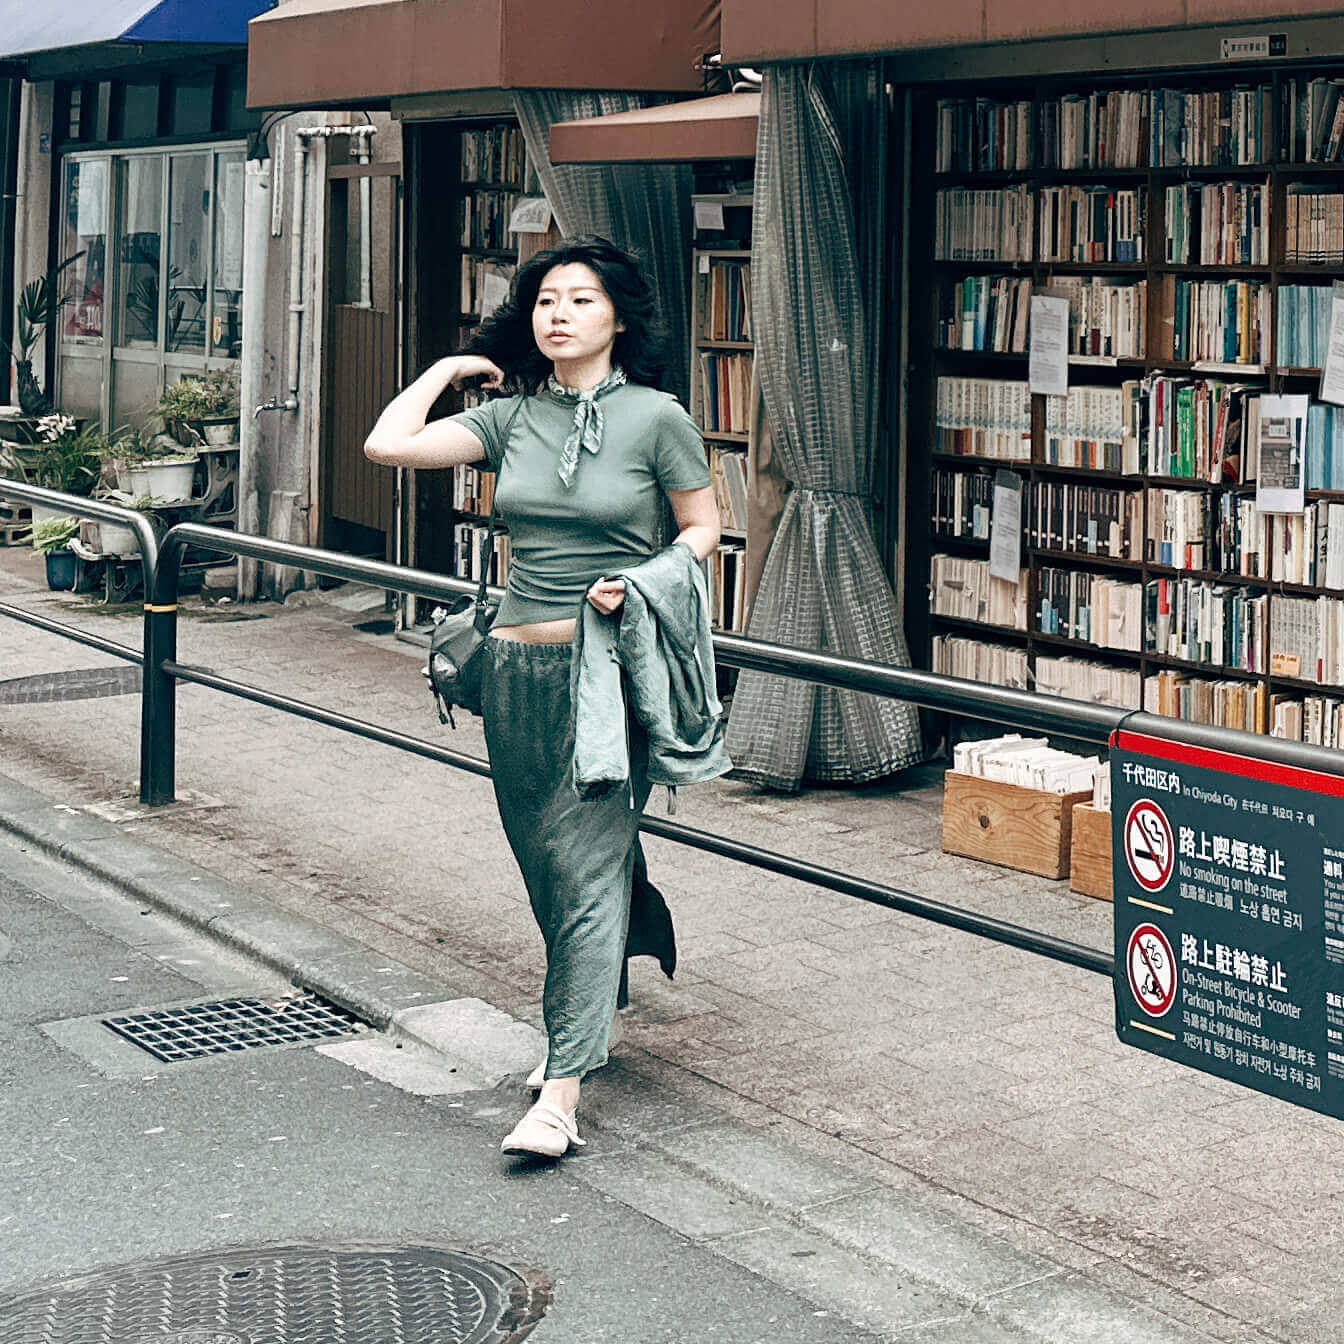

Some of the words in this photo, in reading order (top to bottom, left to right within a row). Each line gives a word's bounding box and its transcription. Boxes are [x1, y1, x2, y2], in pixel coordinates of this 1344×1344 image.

[1122, 762, 1181, 795] 千代田区内
[1191, 788, 1222, 805] Chiyoda
[1222, 794, 1238, 810] City
[1178, 826, 1286, 881] 路上喫煙禁止
[1179, 860, 1191, 877] No
[1193, 865, 1230, 892] smoking
[1231, 878, 1243, 891] on
[1244, 875, 1258, 896] the
[1260, 882, 1288, 904] street
[1282, 910, 1302, 932] 금지
[1181, 932, 1288, 993] 路上駐輪禁止
[1182, 967, 1222, 996] On-Street
[1224, 981, 1256, 1006] Bicycle
[1257, 991, 1265, 1008] &
[1266, 994, 1302, 1020] Scooter
[1182, 988, 1215, 1017] Parking
[1216, 999, 1262, 1028] Prohibited
